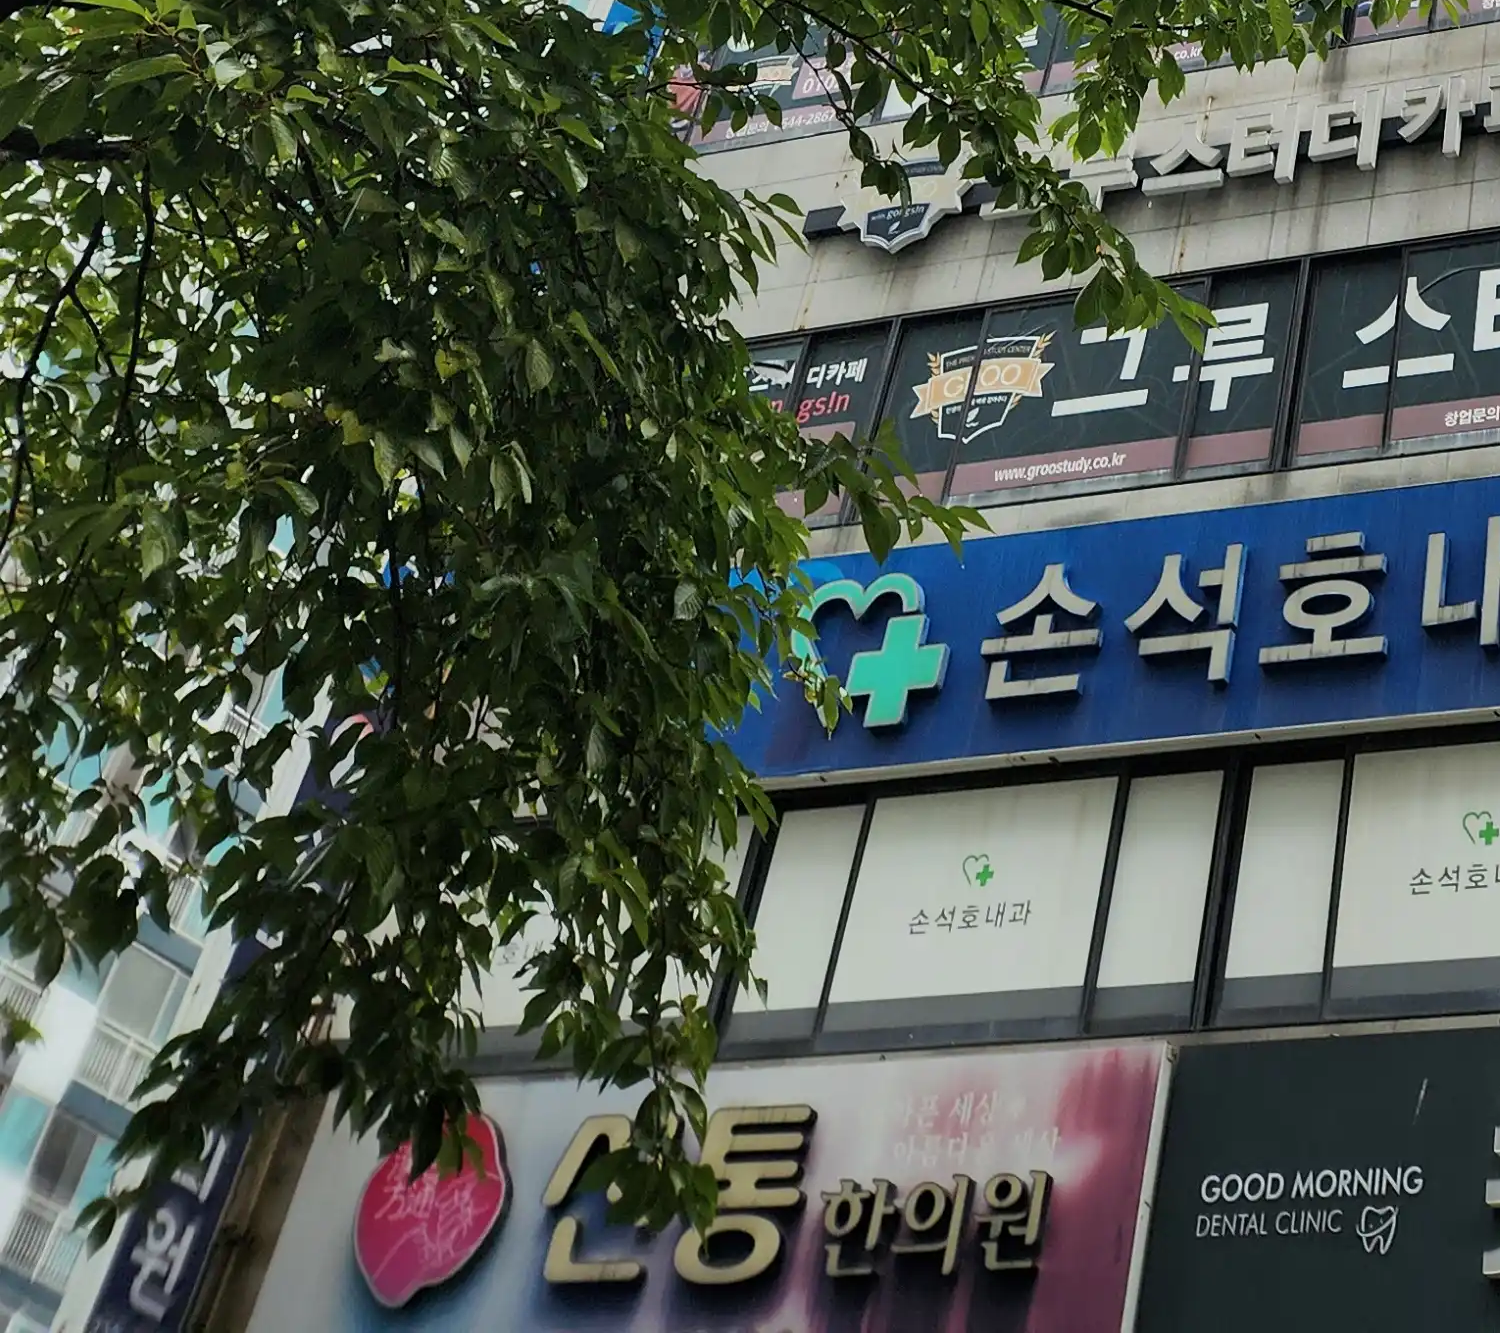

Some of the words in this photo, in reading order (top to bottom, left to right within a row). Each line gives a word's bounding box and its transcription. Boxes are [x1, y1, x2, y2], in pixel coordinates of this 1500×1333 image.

[1051, 301, 1276, 418] 그루
[943, 363, 1022, 398] GOO
[1443, 405, 1500, 428] 창업문의
[993, 451, 1127, 482] www.groostudy.co.kr
[908, 898, 1032, 935] 손석호내과
[1200, 1171, 1285, 1204] GOOD
[1290, 1165, 1424, 1200] MORNING
[820, 1169, 1053, 1279] 한의원
[1195, 1212, 1268, 1238] DENTAL
[1274, 1208, 1344, 1235] CLINIC
